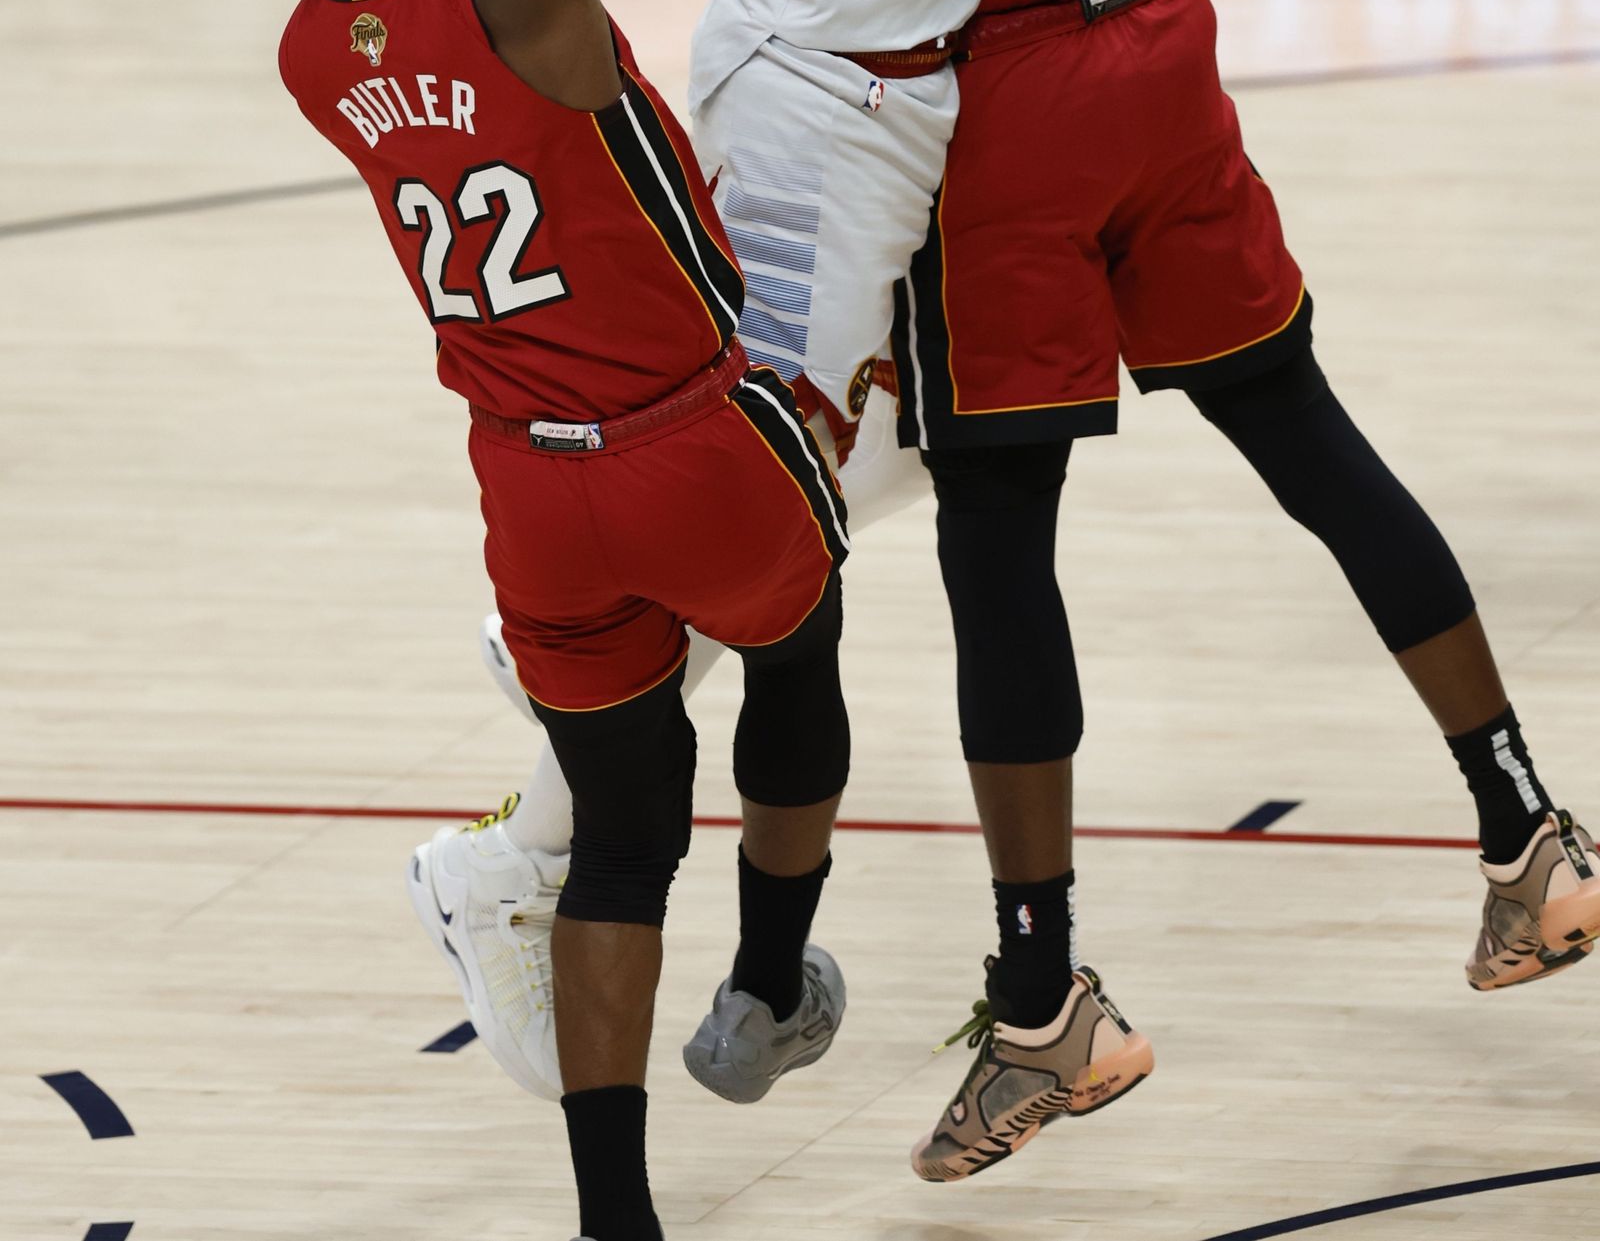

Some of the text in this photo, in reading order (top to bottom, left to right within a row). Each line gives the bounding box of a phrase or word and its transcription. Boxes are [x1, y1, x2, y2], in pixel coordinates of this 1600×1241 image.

[351, 21, 386, 50] Finals
[336, 74, 476, 149] BUTLER
[391, 159, 573, 325] 22
